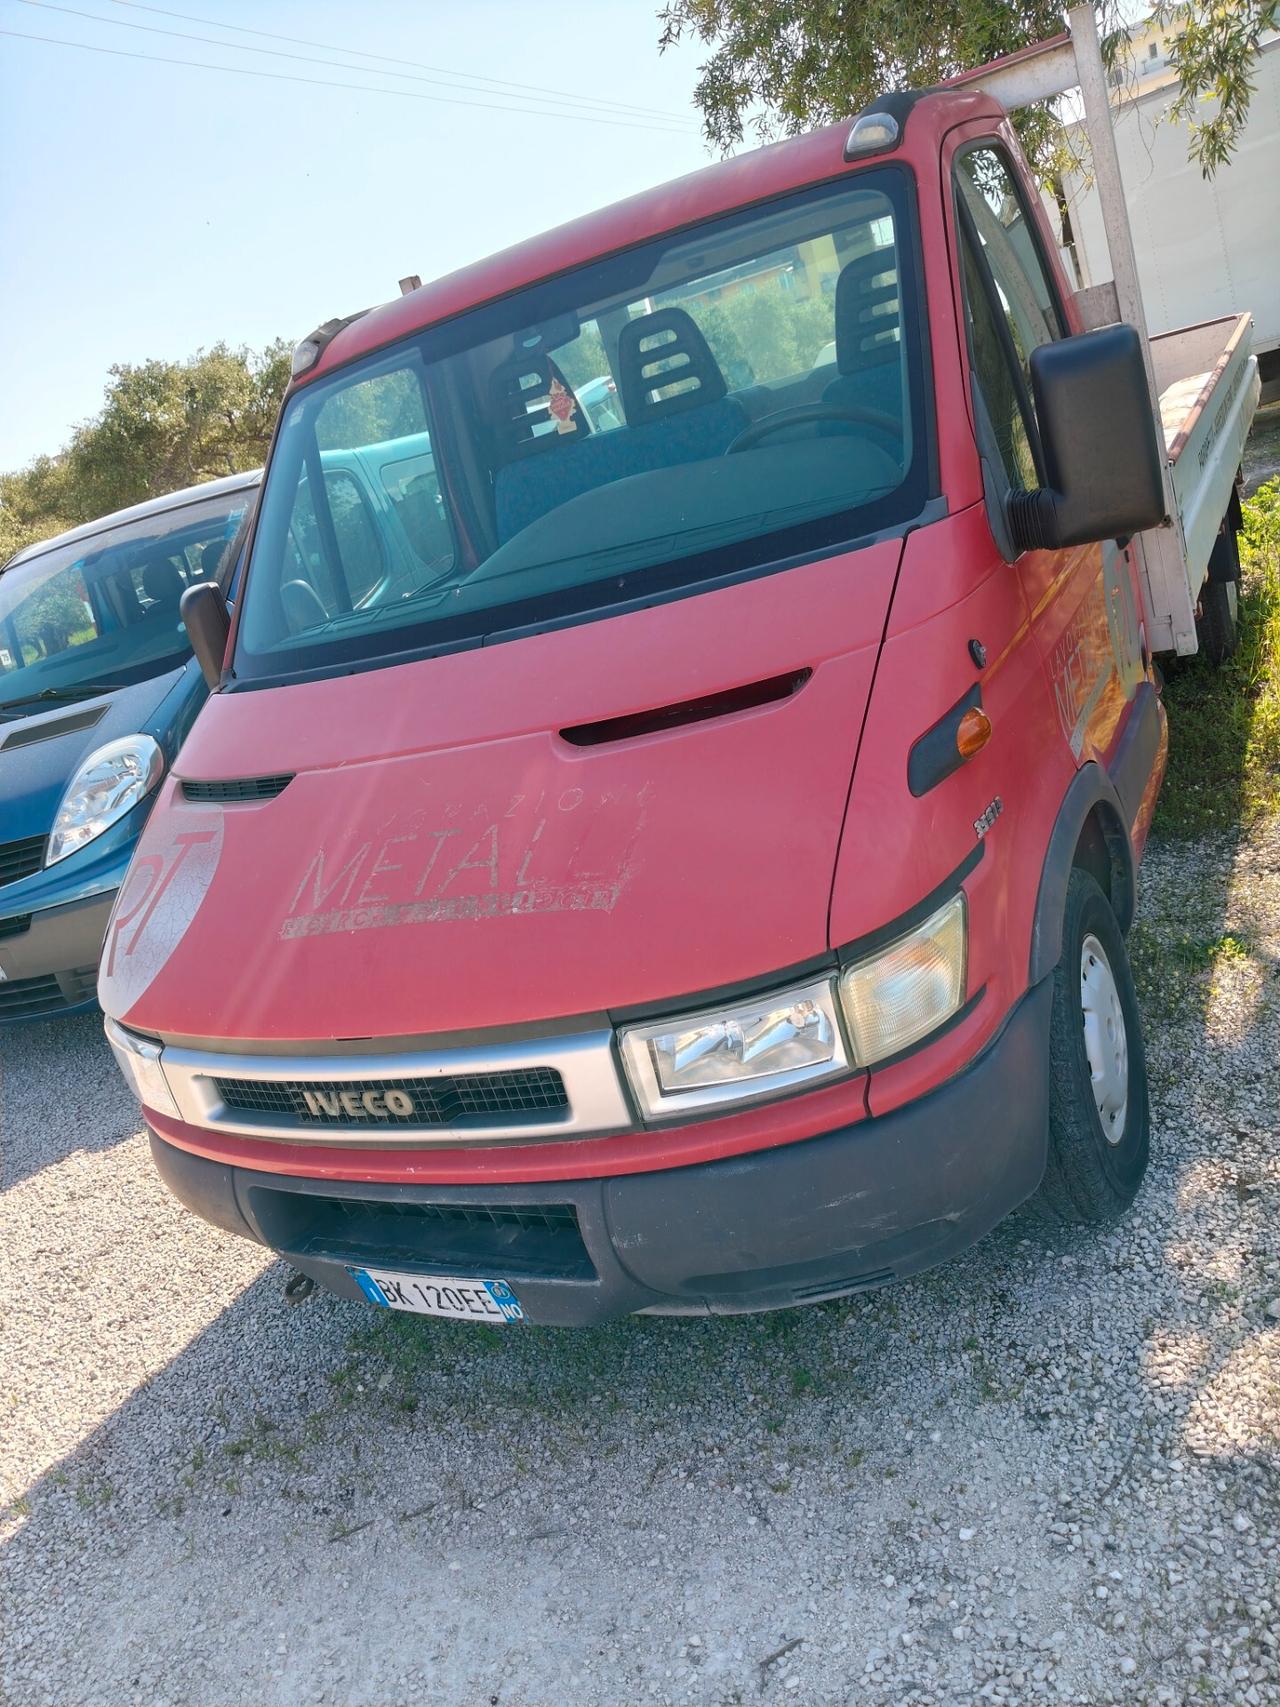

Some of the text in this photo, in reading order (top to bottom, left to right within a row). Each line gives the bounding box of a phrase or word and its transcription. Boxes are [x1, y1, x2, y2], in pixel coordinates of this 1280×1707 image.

[106, 831, 217, 977] PT
[302, 1089, 414, 1116] IVECO
[374, 1278, 414, 1306] BK
[500, 1303, 523, 1319] NO
